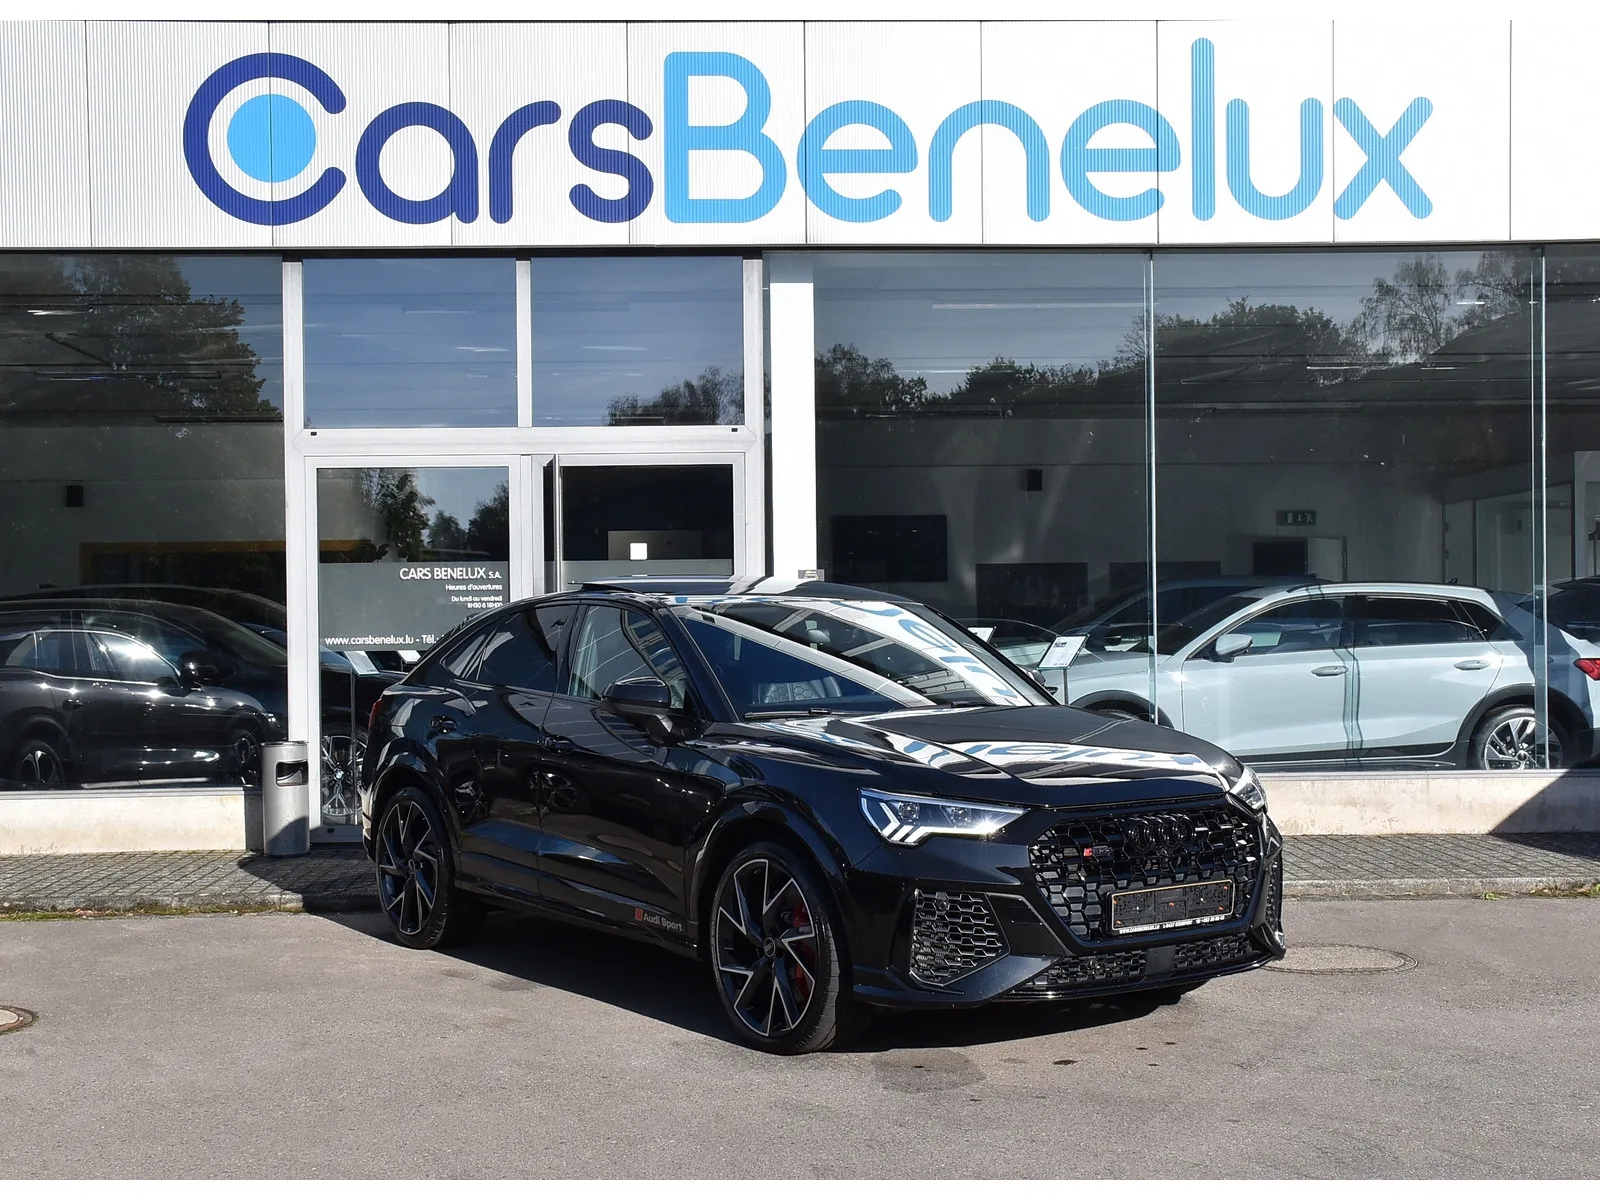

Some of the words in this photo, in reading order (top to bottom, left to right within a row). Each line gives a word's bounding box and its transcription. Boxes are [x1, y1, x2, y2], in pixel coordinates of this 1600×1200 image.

[399, 567, 432, 580] CARS
[433, 566, 487, 580] BENELUX
[445, 583, 467, 591] Heures
[324, 634, 414, 645] www.carsbenelux.lu
[643, 913, 661, 925] Audi
[661, 917, 682, 931] Sport
